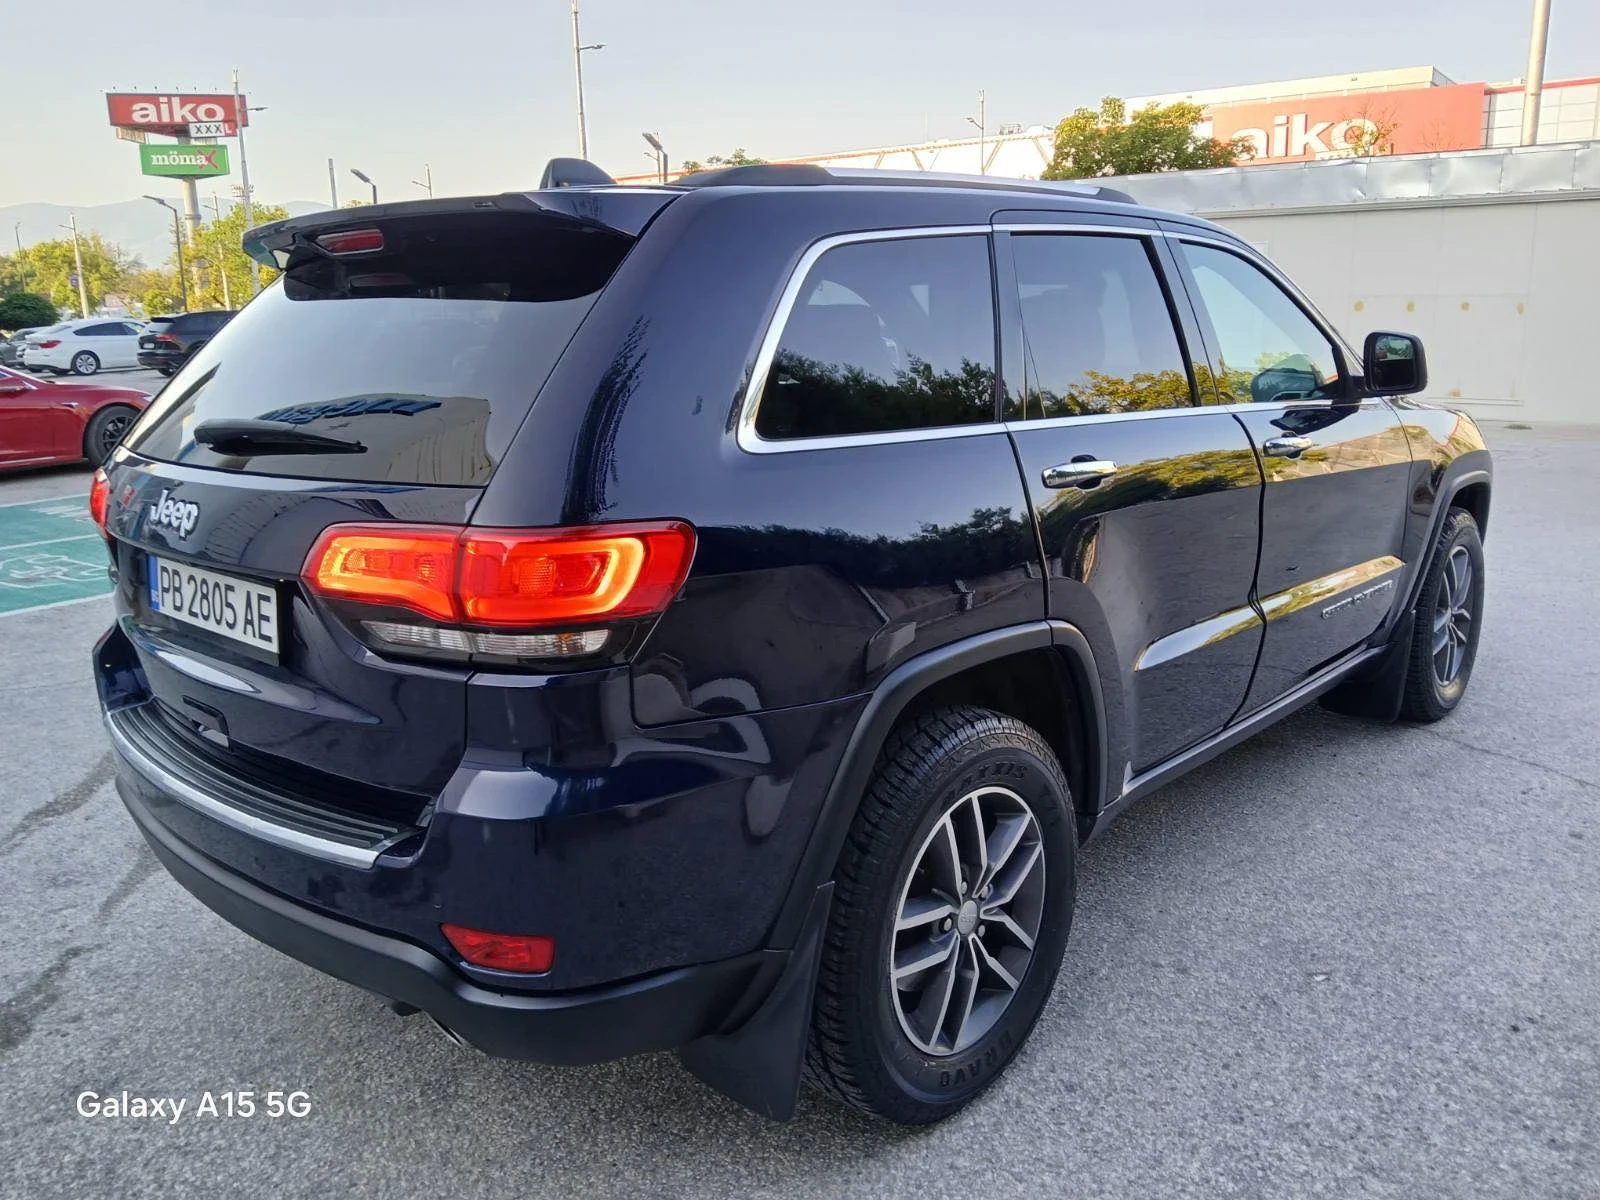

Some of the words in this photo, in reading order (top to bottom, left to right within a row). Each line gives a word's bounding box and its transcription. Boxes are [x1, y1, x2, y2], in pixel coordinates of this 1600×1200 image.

[131, 97, 225, 123] aiko
[194, 123, 232, 135] XXXL
[1231, 113, 1378, 160] aiko
[151, 489, 199, 538] Jeep
[160, 565, 184, 612] PB
[188, 574, 237, 630] 2805
[243, 590, 273, 643] AE
